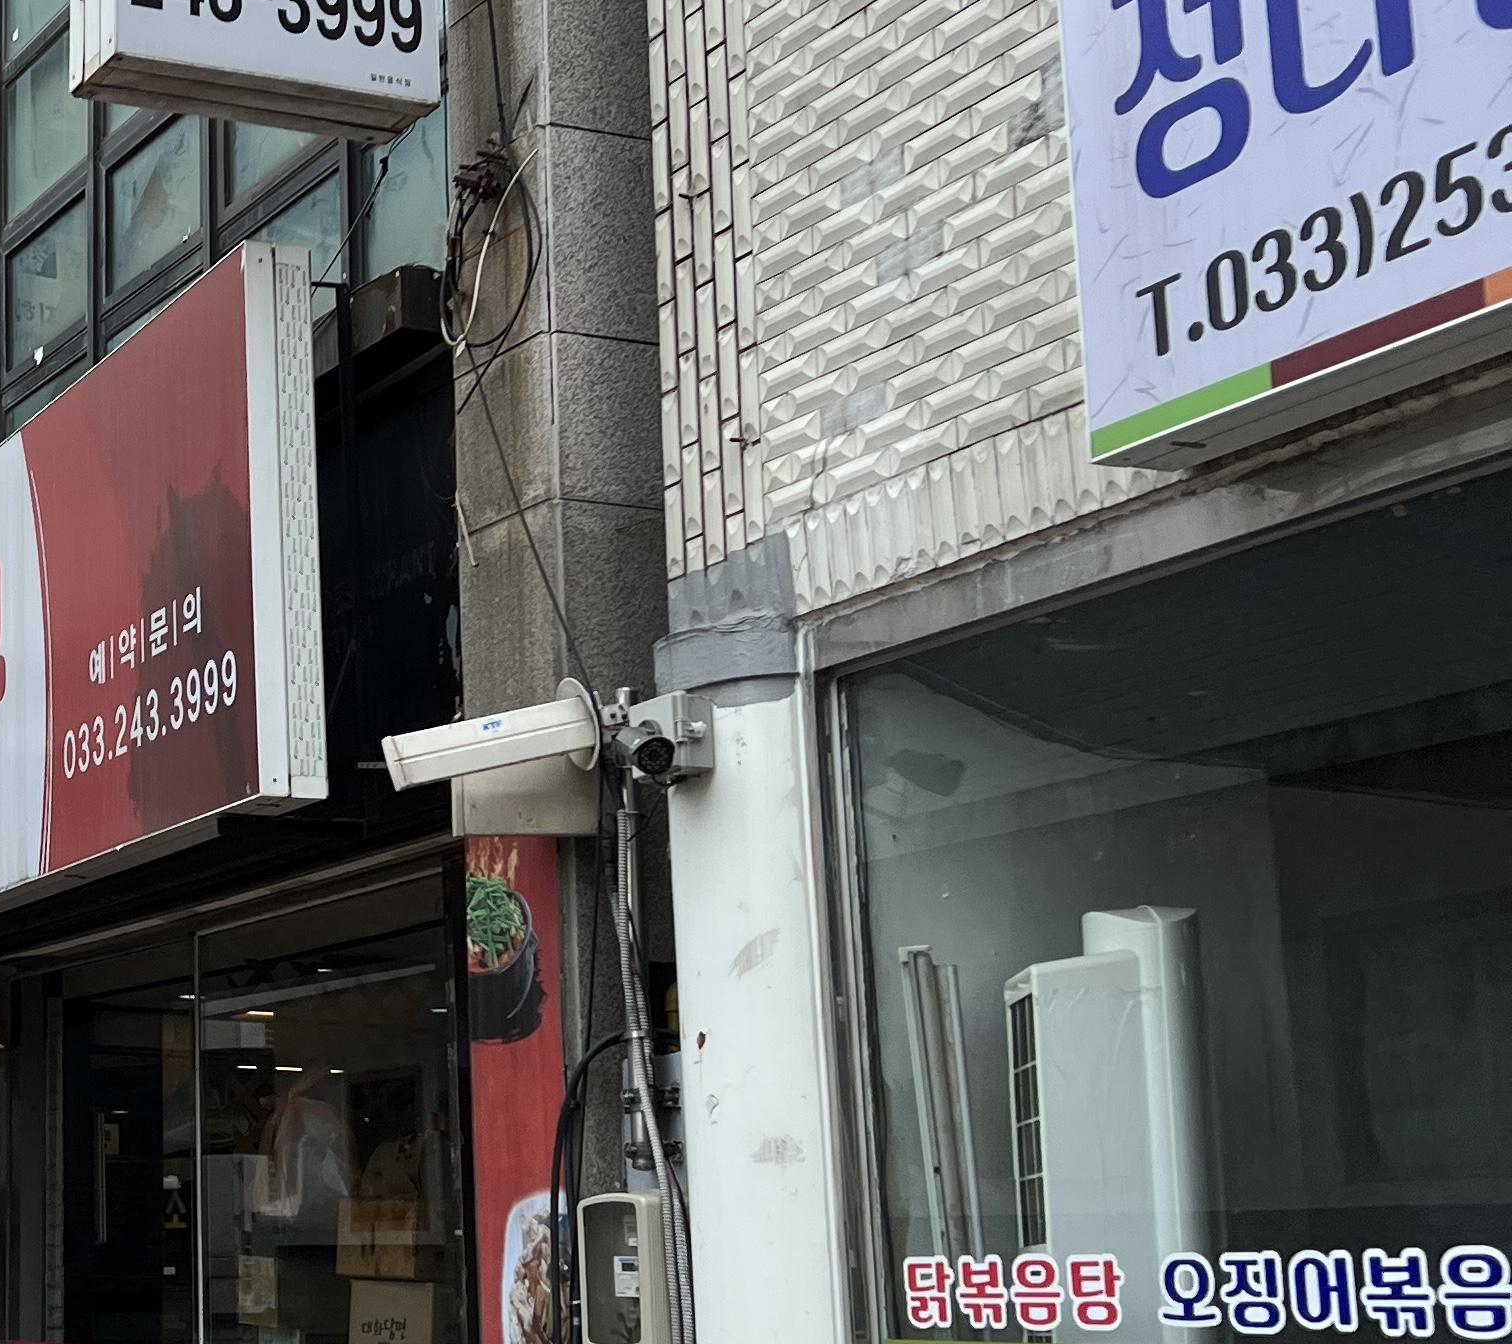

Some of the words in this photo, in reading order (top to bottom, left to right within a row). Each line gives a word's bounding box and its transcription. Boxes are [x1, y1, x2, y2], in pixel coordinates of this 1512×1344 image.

[63, 650, 238, 780] 033.243.3999
[905, 1257, 1123, 1328] 닭볶음탕
[1162, 1249, 1512, 1334] 오징어볶음
